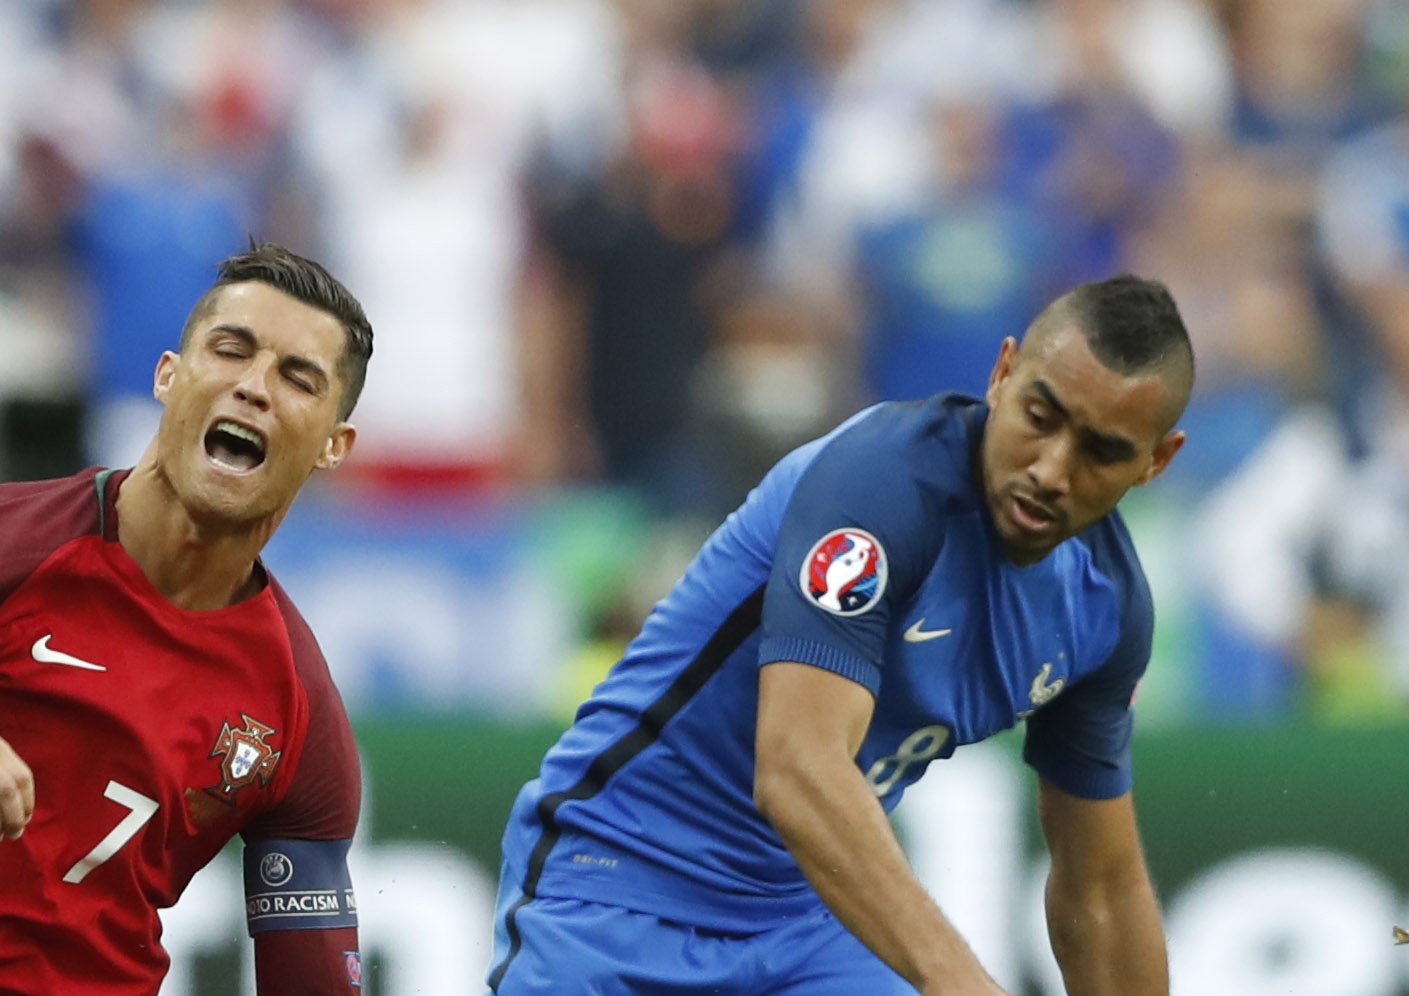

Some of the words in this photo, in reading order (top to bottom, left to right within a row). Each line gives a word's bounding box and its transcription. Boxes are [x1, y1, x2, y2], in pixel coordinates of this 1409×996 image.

[865, 724, 950, 798] 8
[61, 779, 160, 885] 7
[274, 895, 340, 912] RACISM
